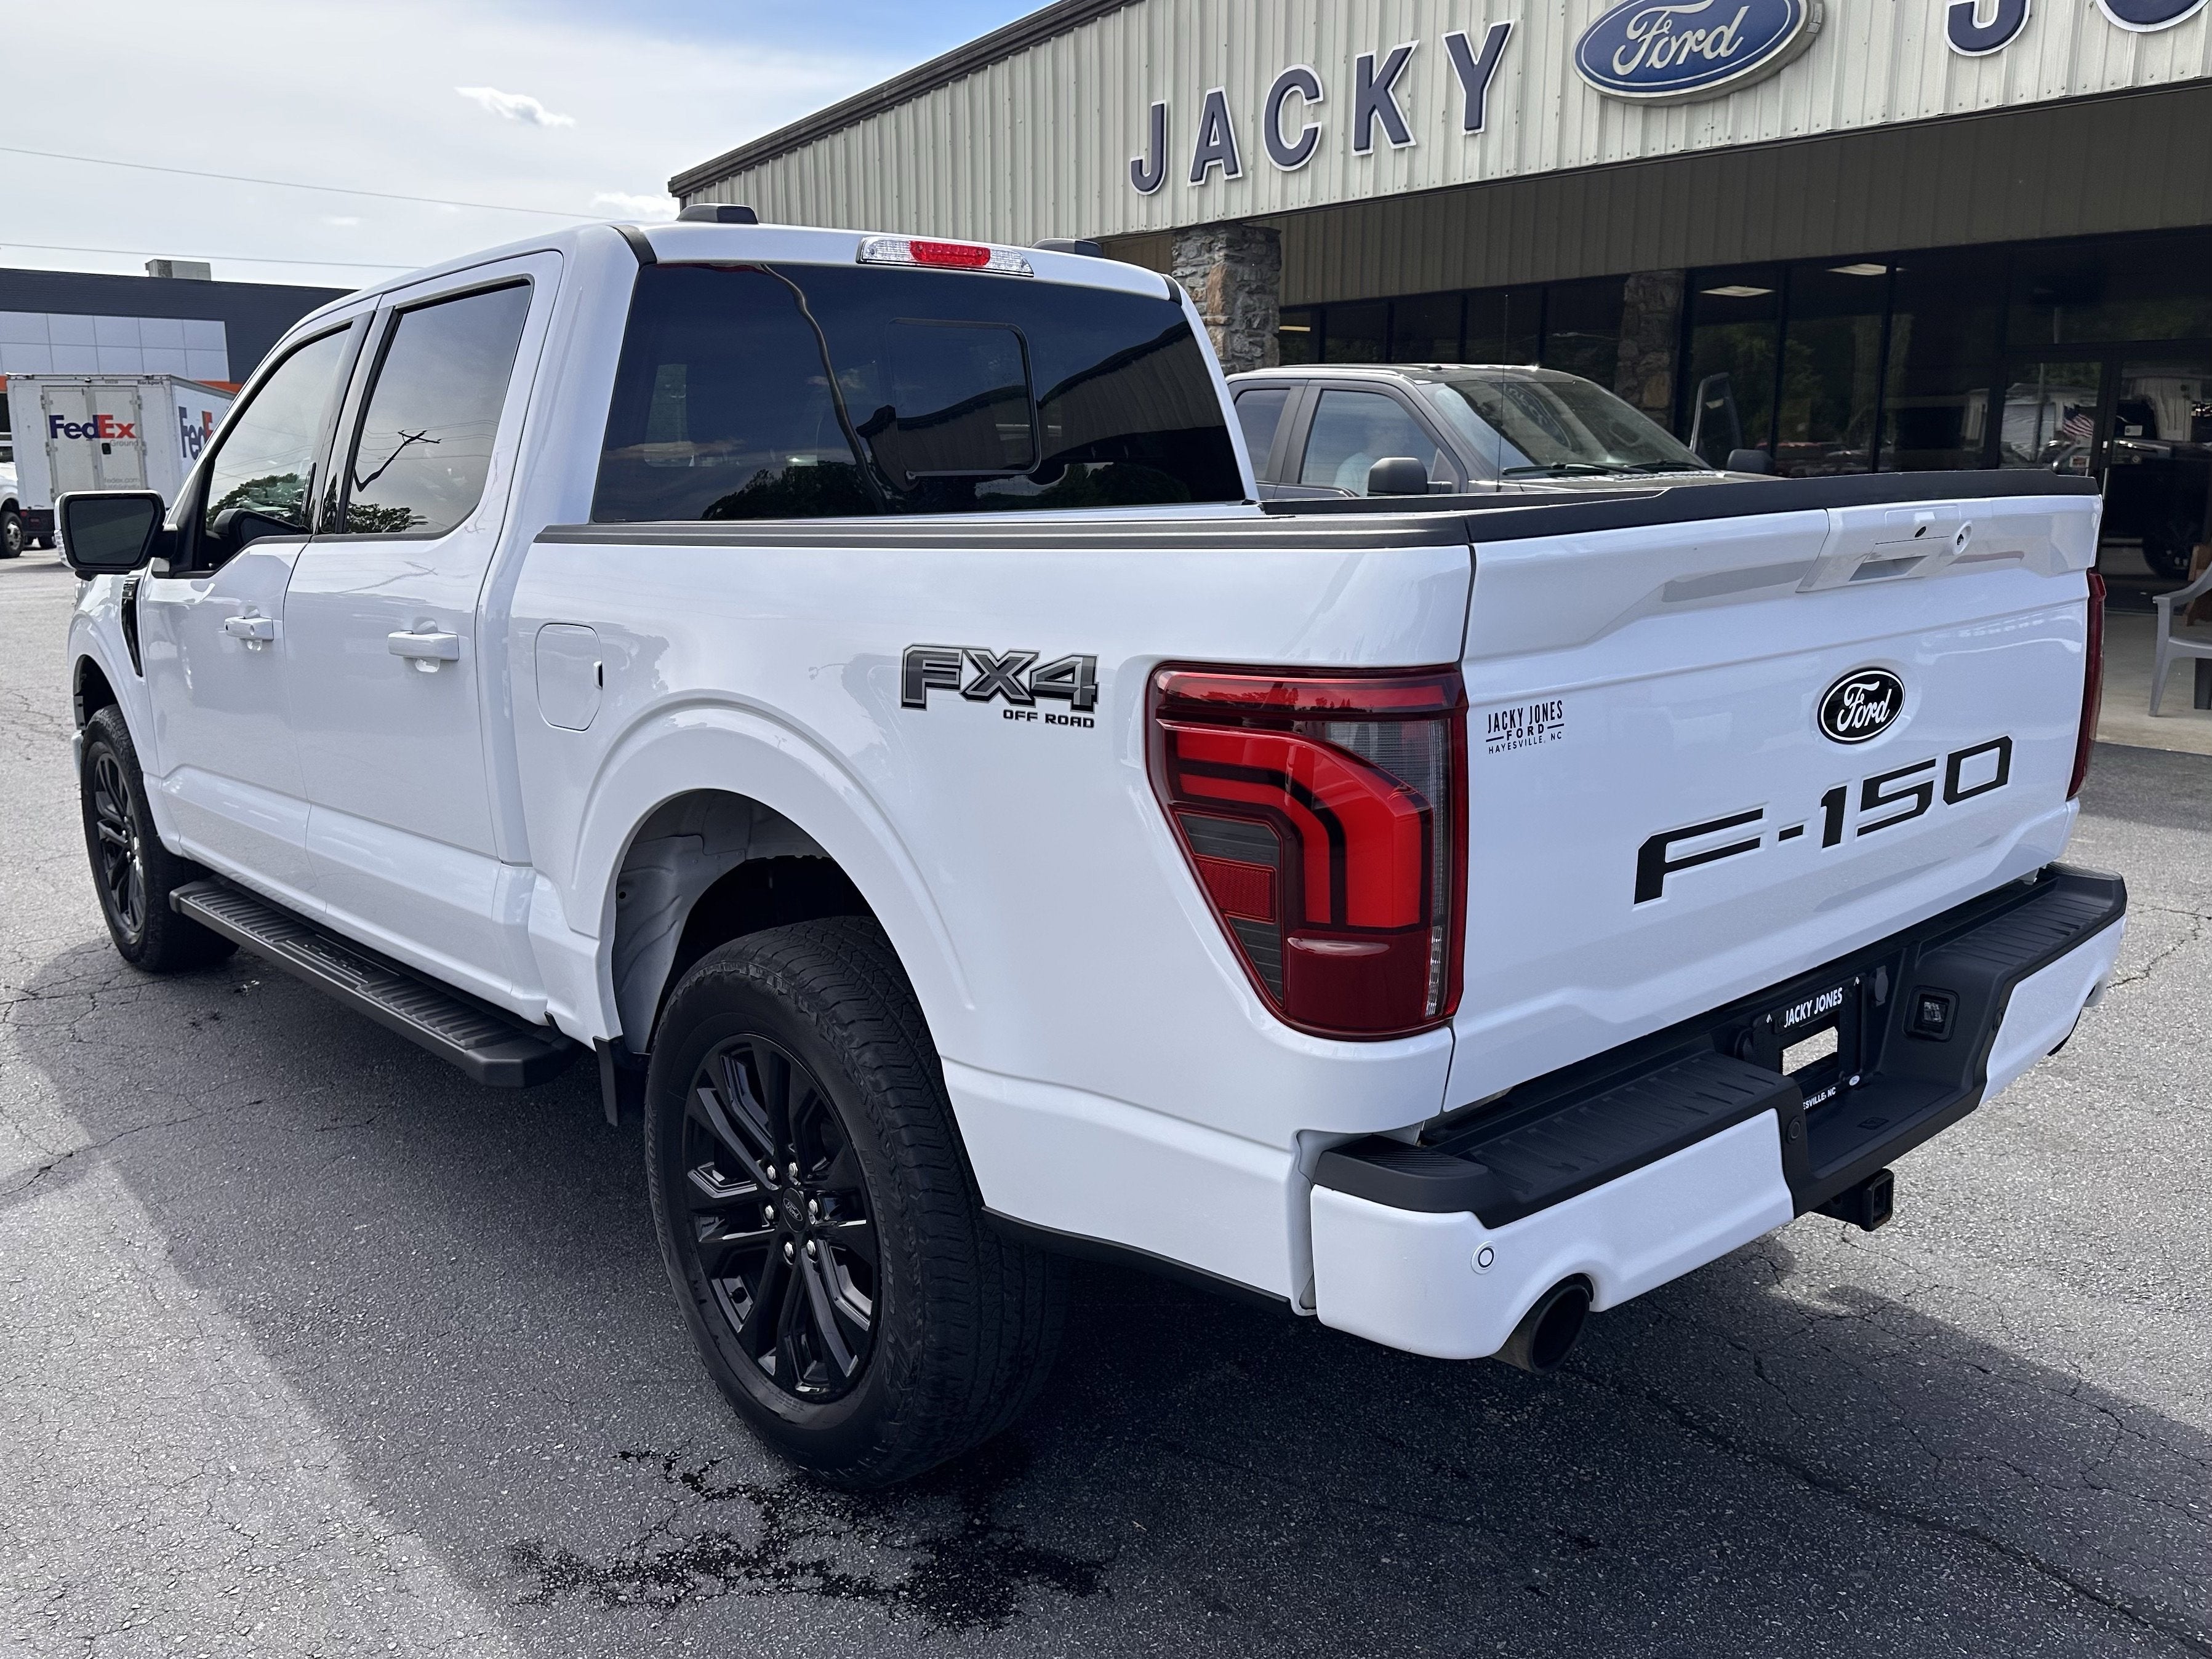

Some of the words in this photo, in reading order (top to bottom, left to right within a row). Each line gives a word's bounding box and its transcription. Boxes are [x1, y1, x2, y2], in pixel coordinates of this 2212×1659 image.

[1613, 0, 1750, 76] Ford
[1130, 19, 1516, 196] JACKY
[49, 414, 137, 439] FedEx
[901, 643, 1099, 714] FX4
[1003, 709, 1038, 721] OFF
[1045, 713, 1094, 729] ROAD
[1488, 708, 1523, 734] JACKY
[1529, 700, 1563, 726] JONES
[1837, 680, 1893, 732] Ford
[1507, 724, 1544, 741] FORD
[1550, 732, 1562, 742] NC
[1634, 735, 2013, 905] F-150
[1784, 999, 1813, 1028] JACKY
[1814, 987, 1843, 1015] JONES
[1827, 1087, 1836, 1098] NC
[785, 1201, 799, 1219] Ford
